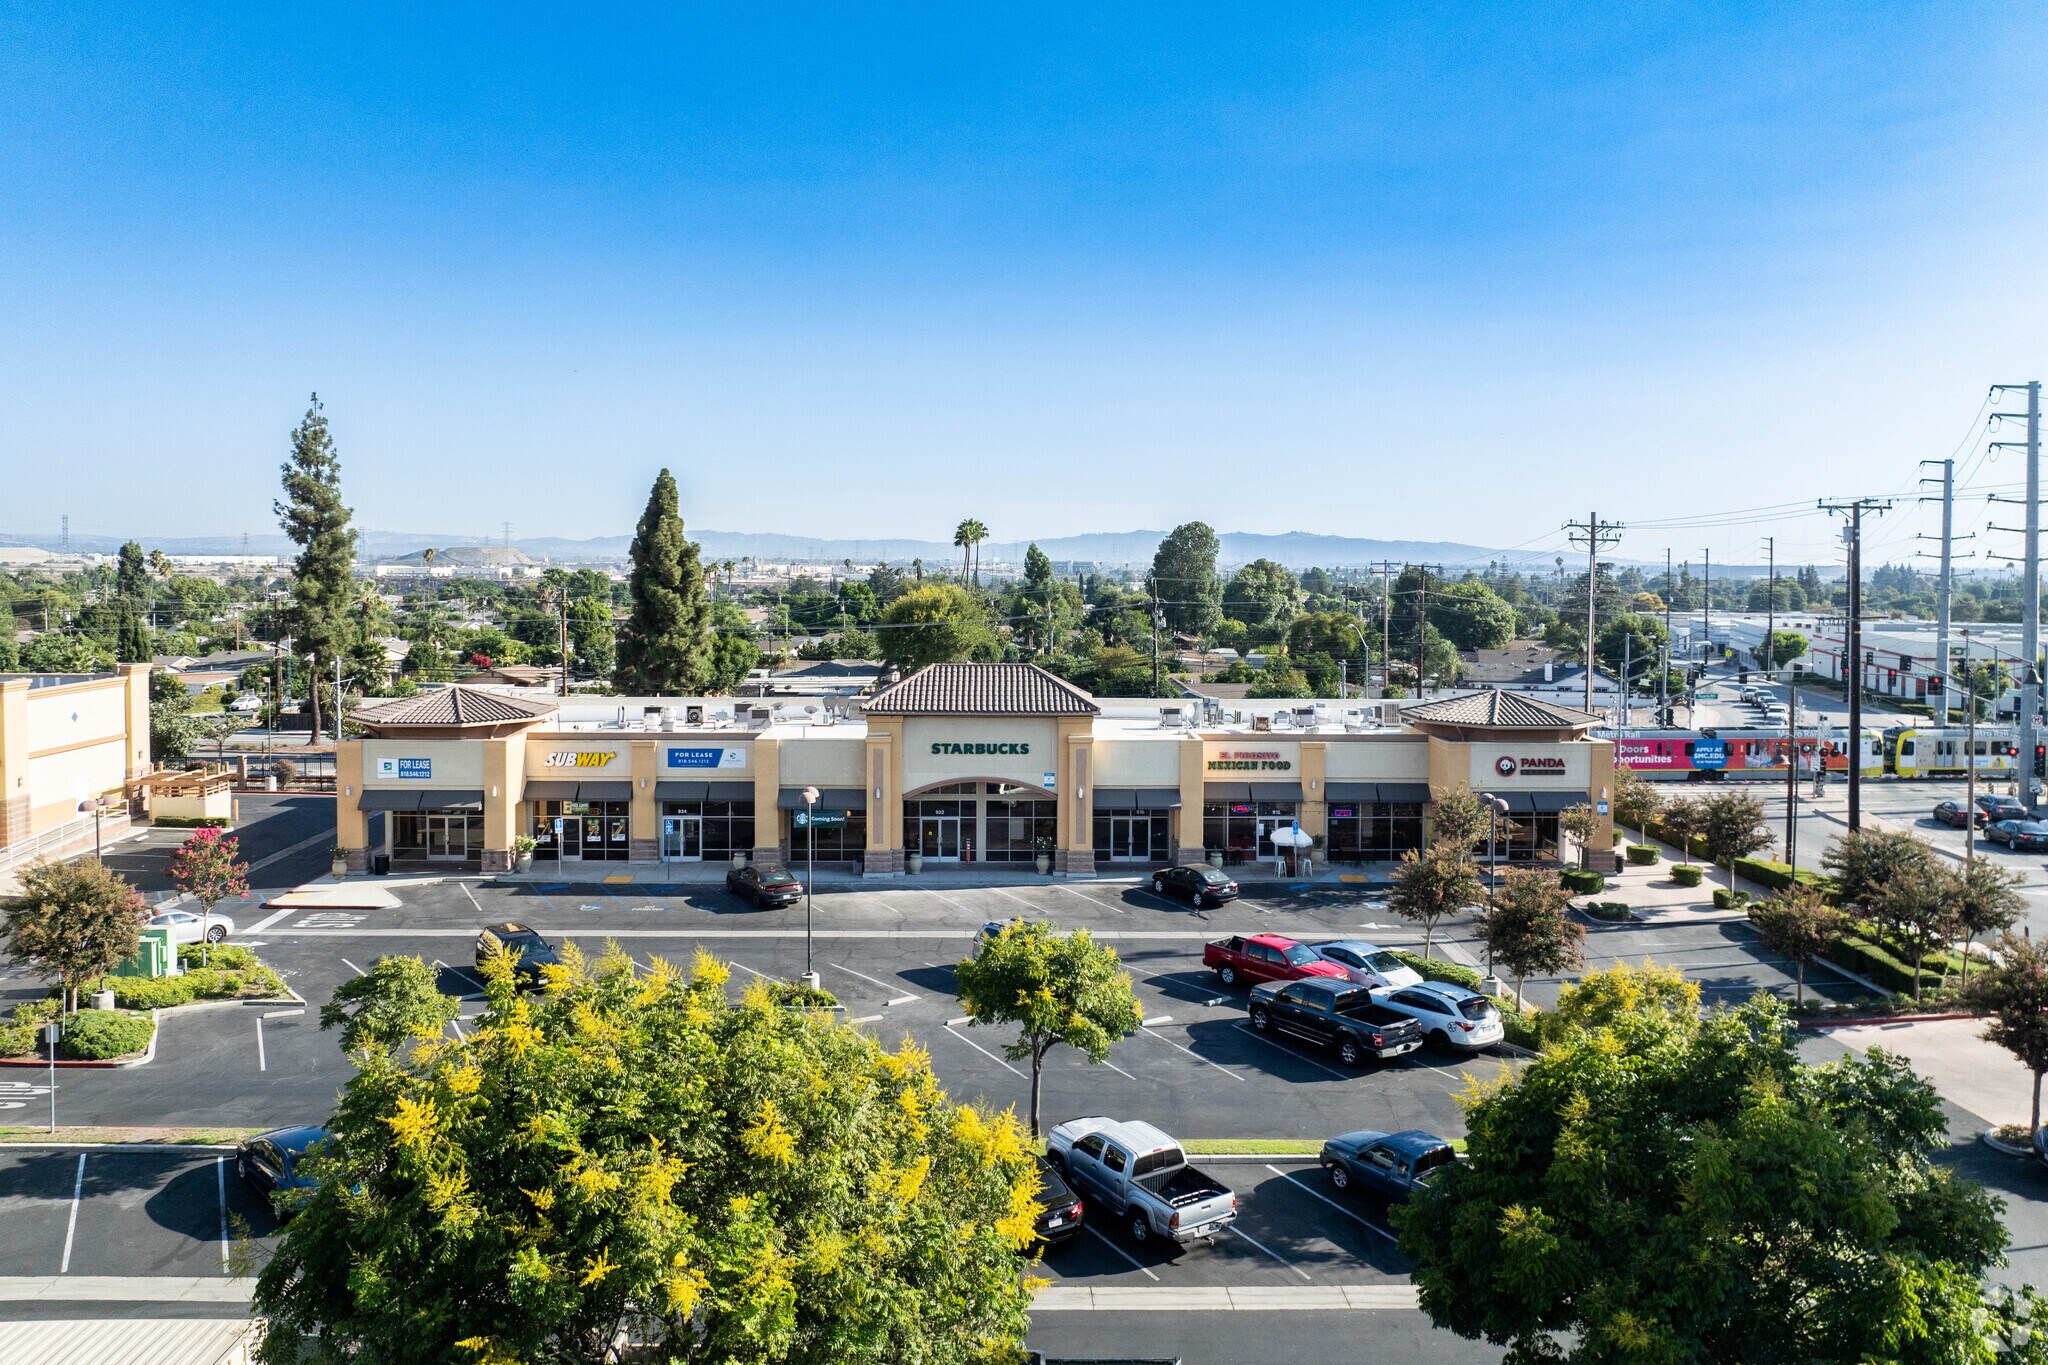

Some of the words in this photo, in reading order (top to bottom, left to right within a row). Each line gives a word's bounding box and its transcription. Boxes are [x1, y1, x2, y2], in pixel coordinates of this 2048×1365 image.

[1624, 730, 1640, 739] Rail
[931, 743, 1030, 755] STARBUCKS
[1620, 745, 1649, 753] Doors
[543, 751, 617, 767] SUBWAY
[1219, 752, 1231, 760] EL
[400, 760, 412, 769] FOR
[412, 760, 430, 769] LEASE
[1208, 761, 1258, 770] MEXICAN
[1262, 761, 1291, 770] FOOD
[1520, 758, 1565, 768] PANDA
